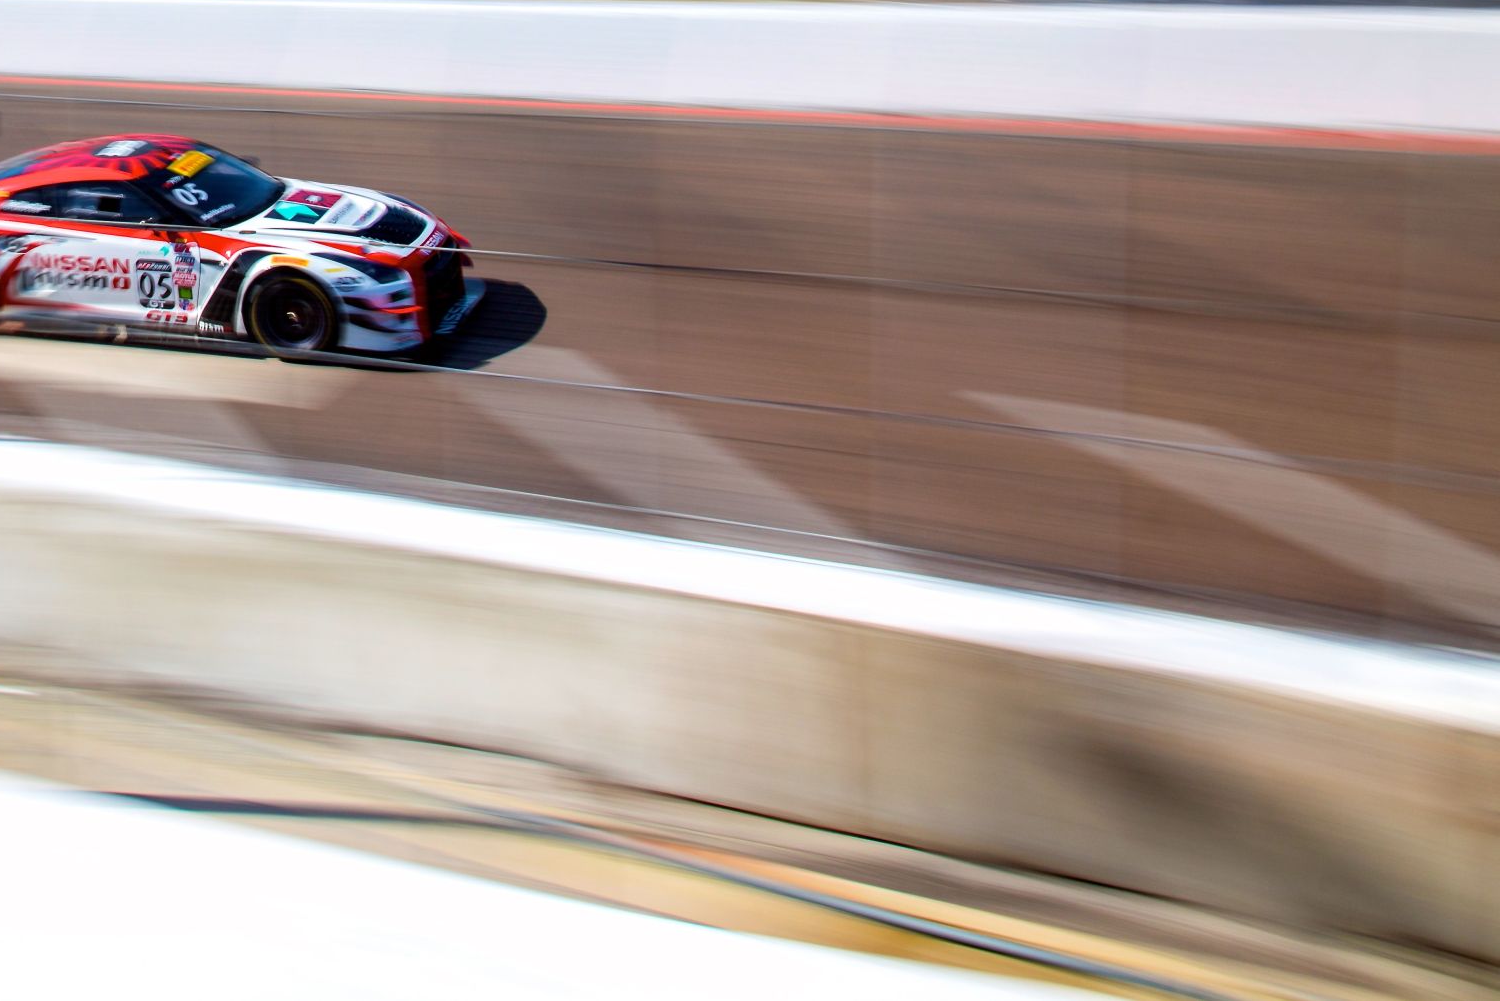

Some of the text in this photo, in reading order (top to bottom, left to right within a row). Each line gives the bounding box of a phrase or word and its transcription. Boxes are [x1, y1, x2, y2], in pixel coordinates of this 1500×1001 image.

[172, 183, 208, 205] 05
[33, 253, 131, 274] NISSAN
[140, 272, 172, 299] 05
[149, 300, 166, 308] GT
[146, 310, 188, 323] GT3
